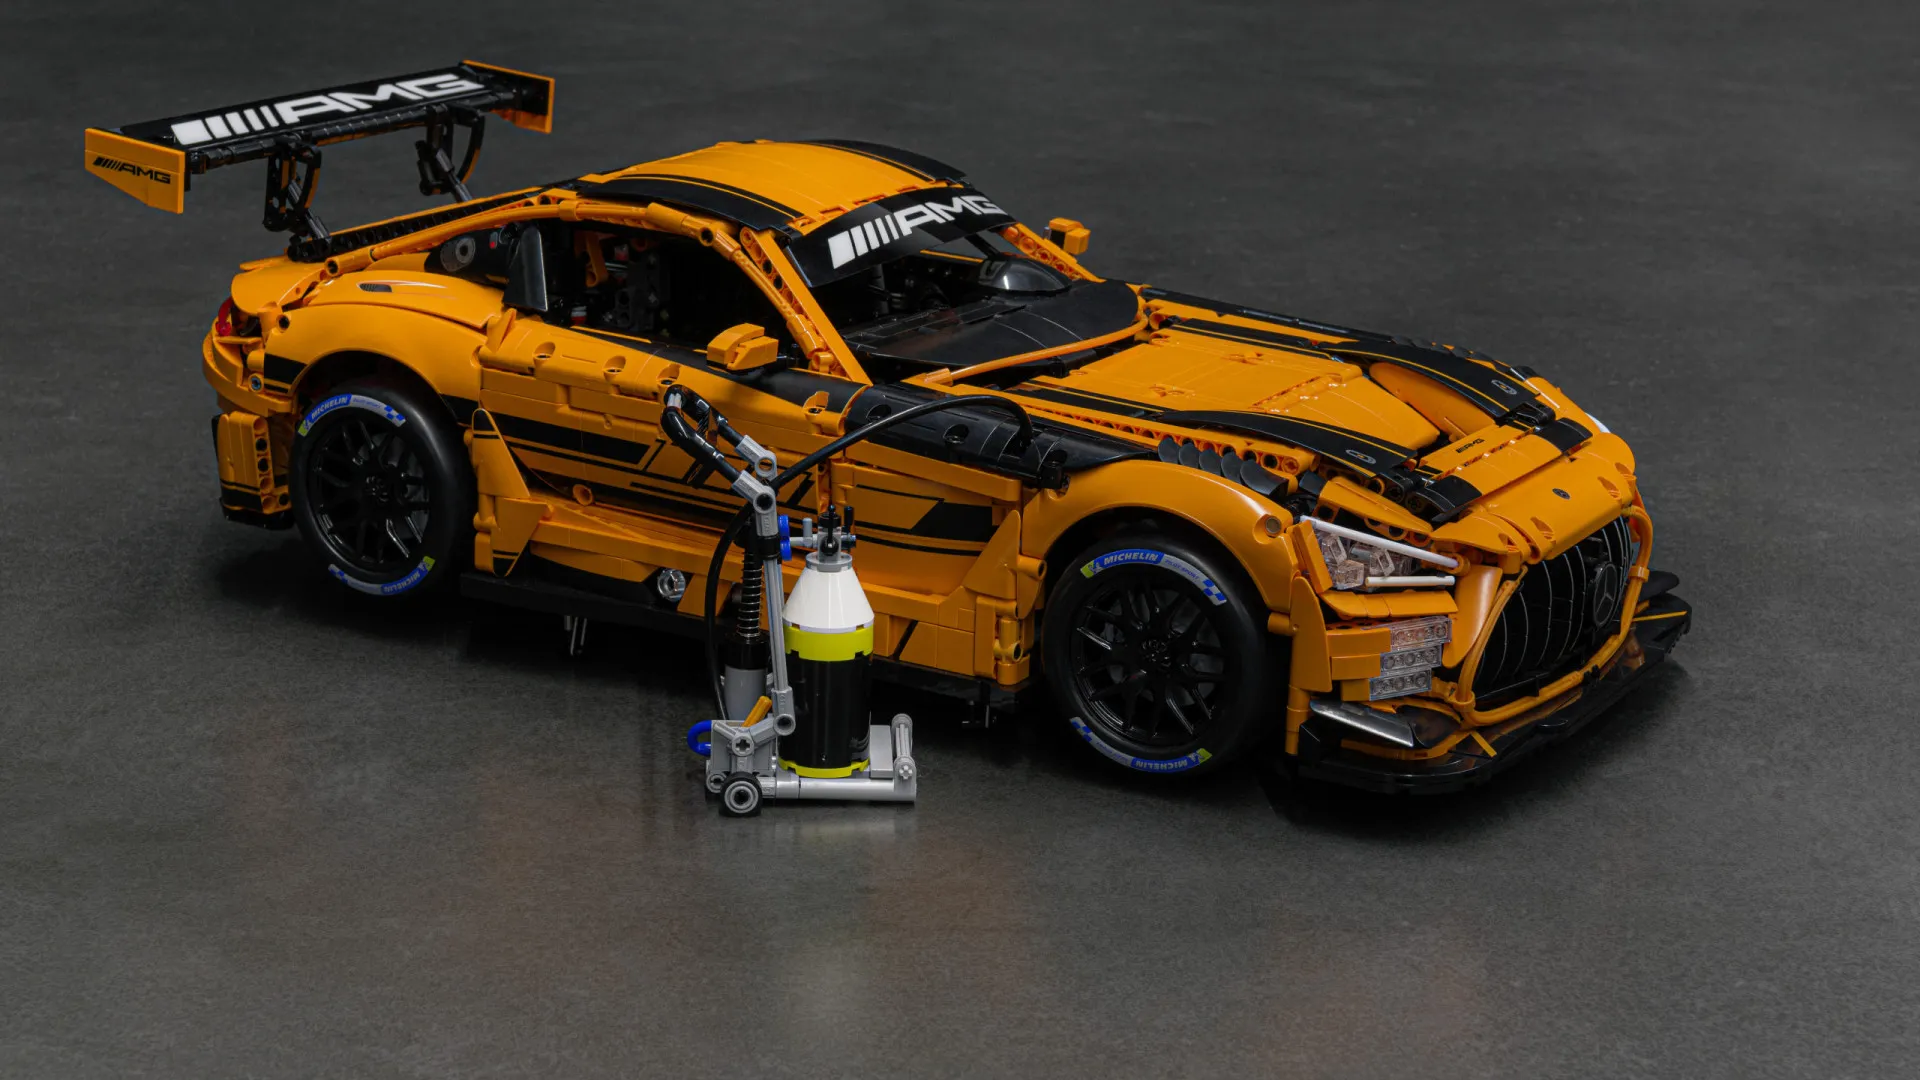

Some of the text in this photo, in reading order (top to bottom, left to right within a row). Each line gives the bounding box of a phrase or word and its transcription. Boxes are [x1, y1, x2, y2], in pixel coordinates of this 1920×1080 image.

[274, 73, 485, 125] AMG
[118, 162, 171, 184] AMG
[893, 195, 1009, 236] AMG
[311, 396, 348, 419] MICHELIN
[1103, 552, 1159, 565] MICHELIN
[384, 571, 420, 593] MICHELIN
[1181, 566, 1200, 580] SPORT
[1135, 759, 1188, 770] MICHELIN
